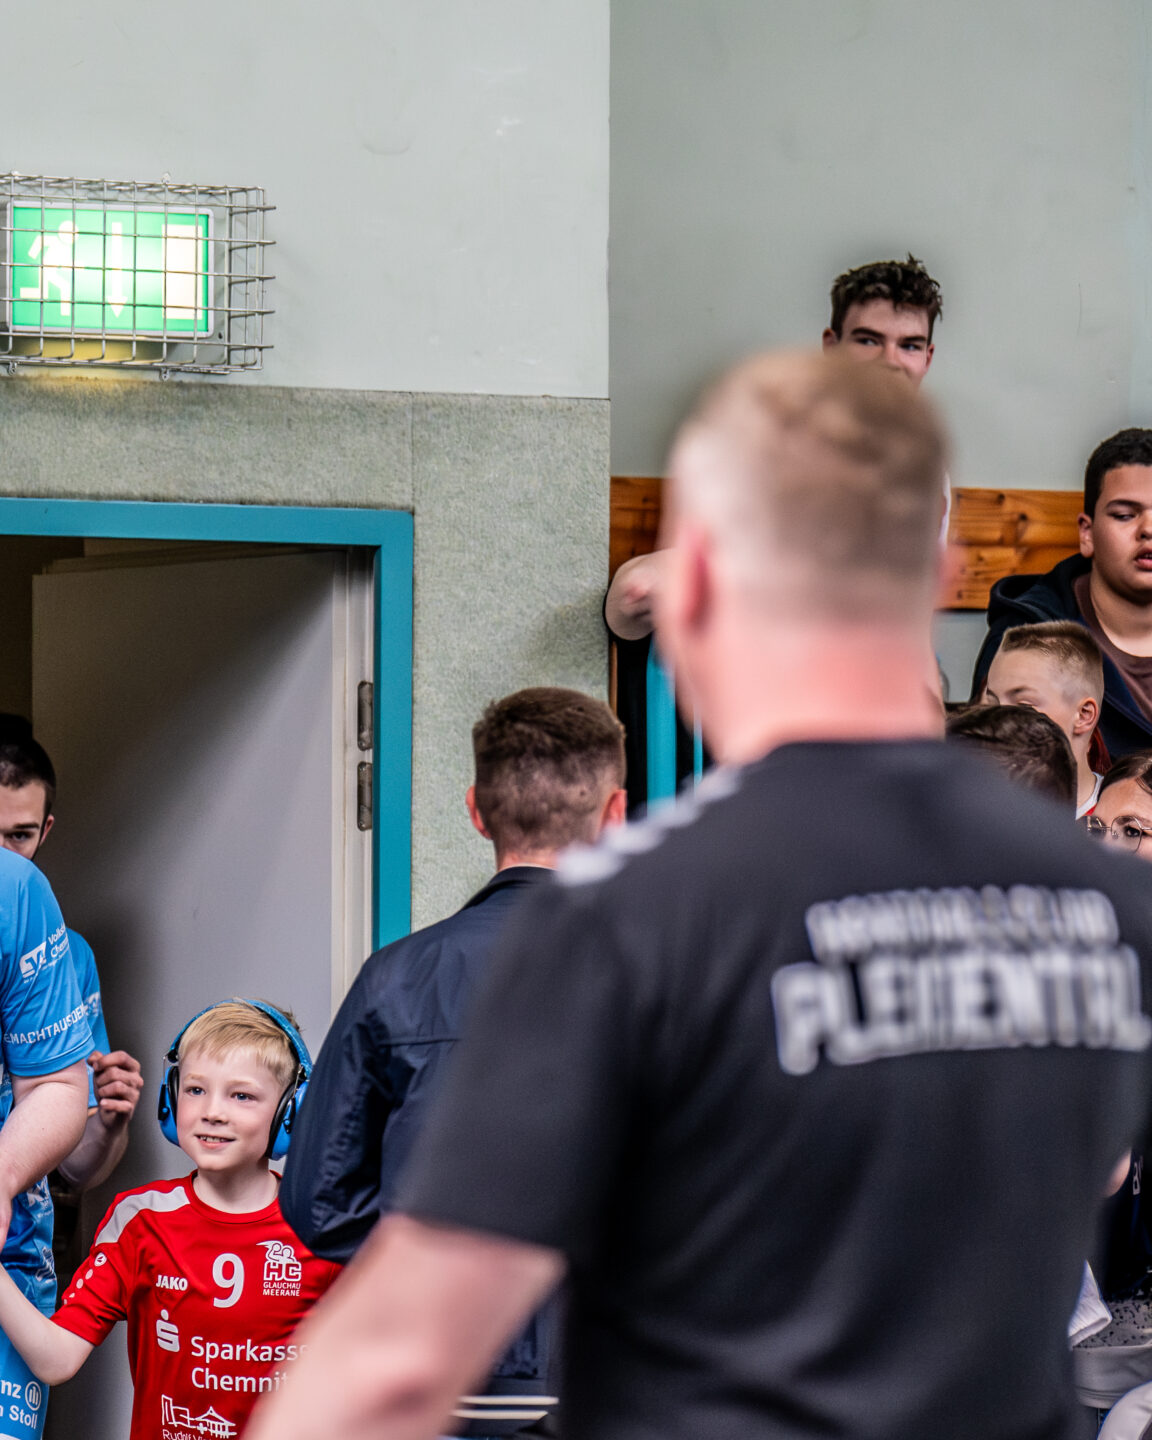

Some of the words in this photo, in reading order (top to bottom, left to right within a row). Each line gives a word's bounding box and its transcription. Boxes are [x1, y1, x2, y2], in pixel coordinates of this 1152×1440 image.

[48, 922, 66, 945] Volks
[212, 1253, 245, 1308] 9
[263, 1260, 302, 1282] HC
[156, 1275, 188, 1291] JAKO
[263, 1281, 301, 1290] GLAUCHAU
[263, 1288, 300, 1297] MEERANE
[9, 1405, 38, 1430] Stoll
